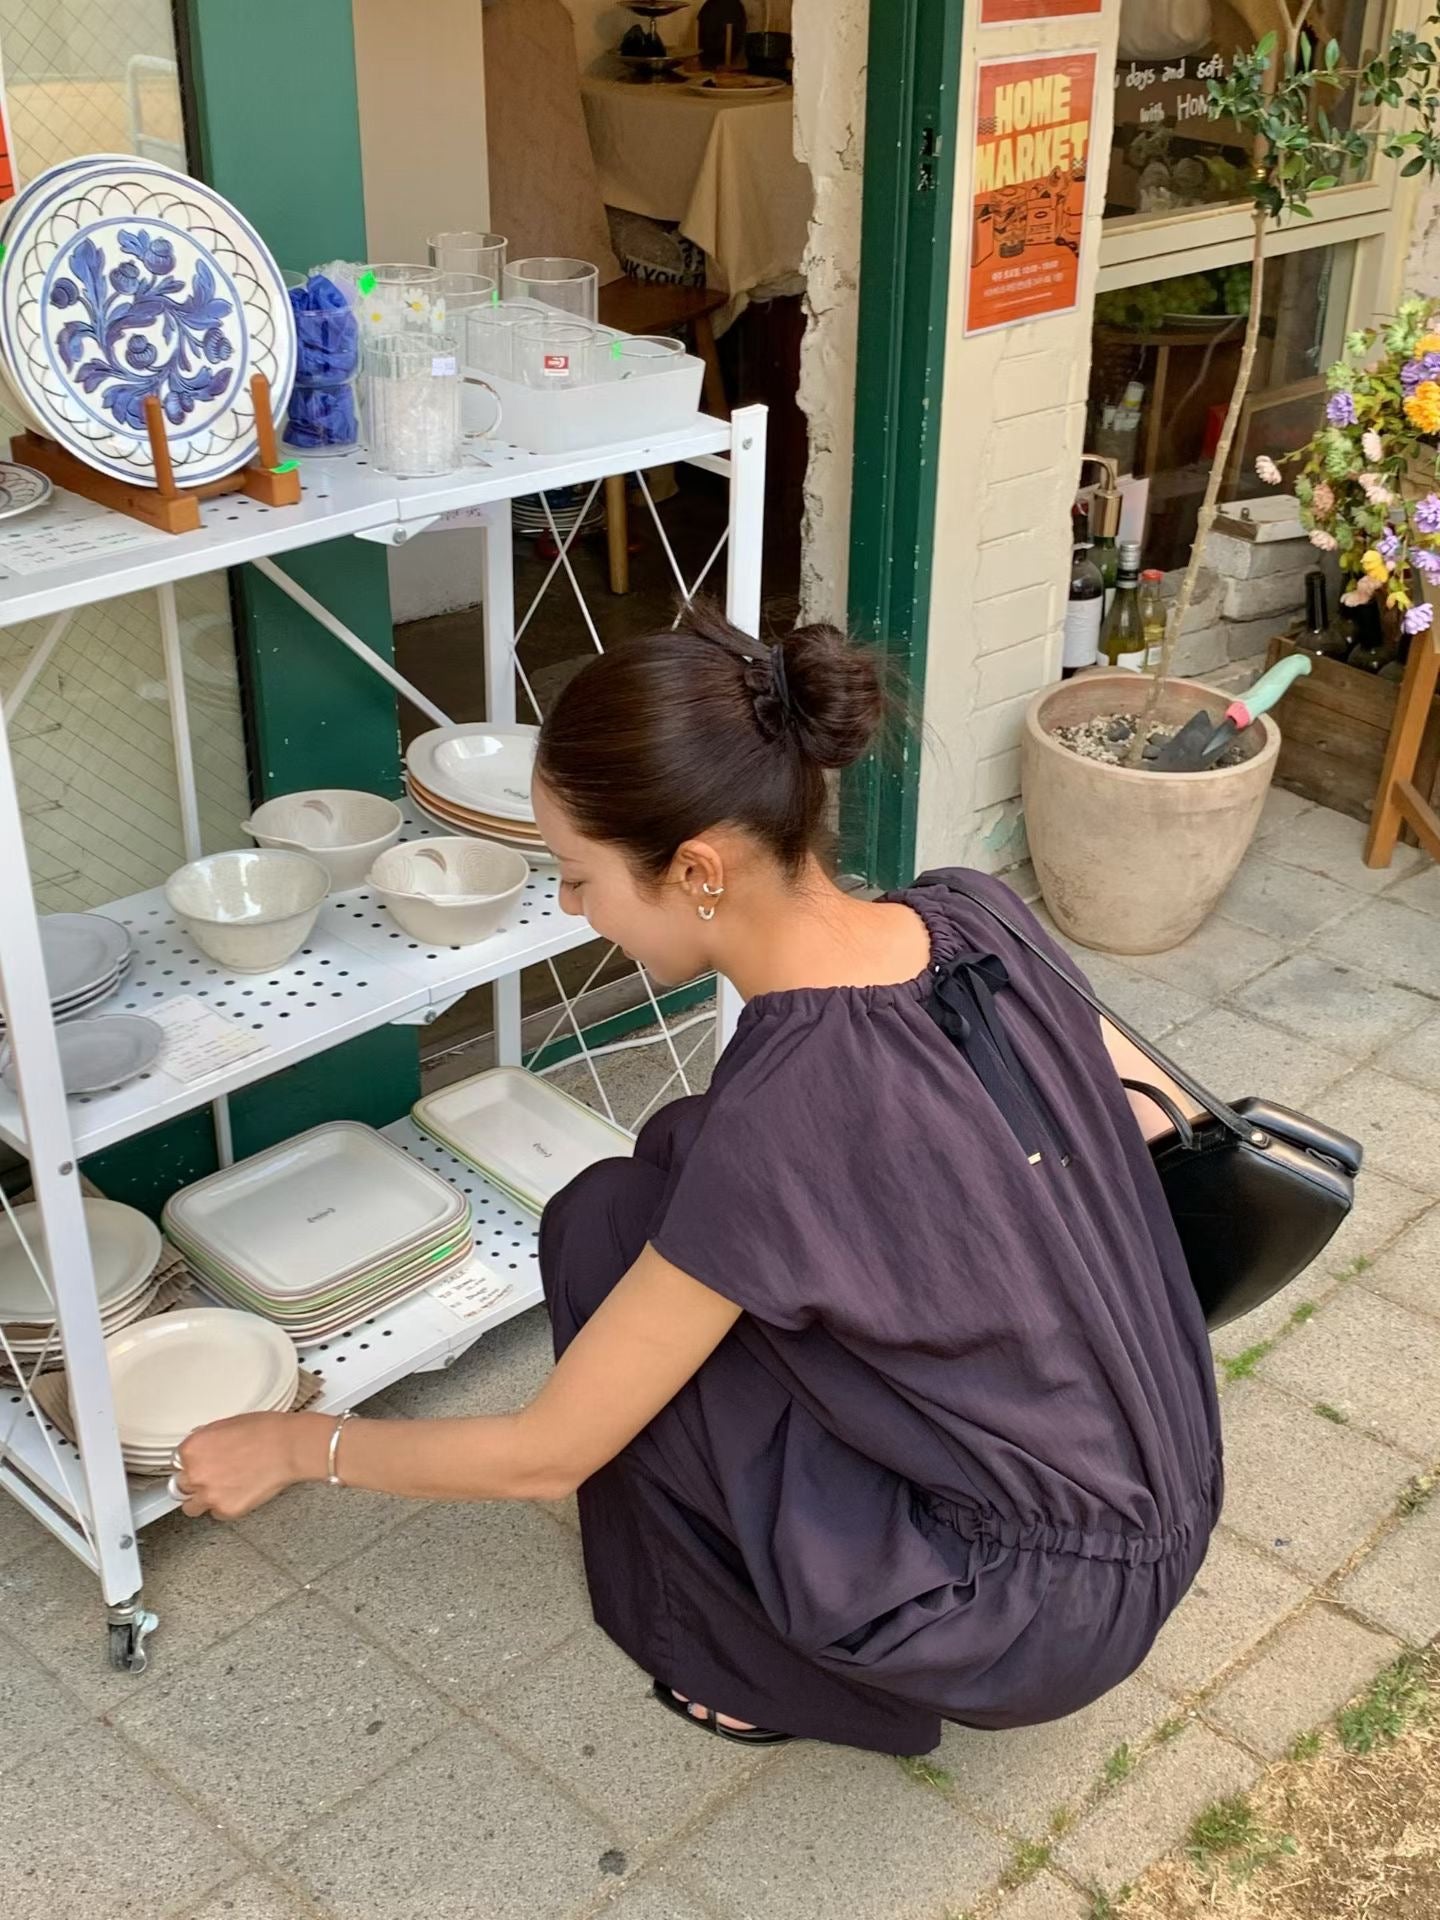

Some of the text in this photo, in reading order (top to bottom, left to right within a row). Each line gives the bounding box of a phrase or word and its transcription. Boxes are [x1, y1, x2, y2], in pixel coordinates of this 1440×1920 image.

[1125, 62, 1155, 90] days
[1162, 58, 1186, 82] and
[1196, 53, 1224, 79] soft
[994, 73, 1071, 136] HOME
[975, 120, 1088, 196] MARKET
